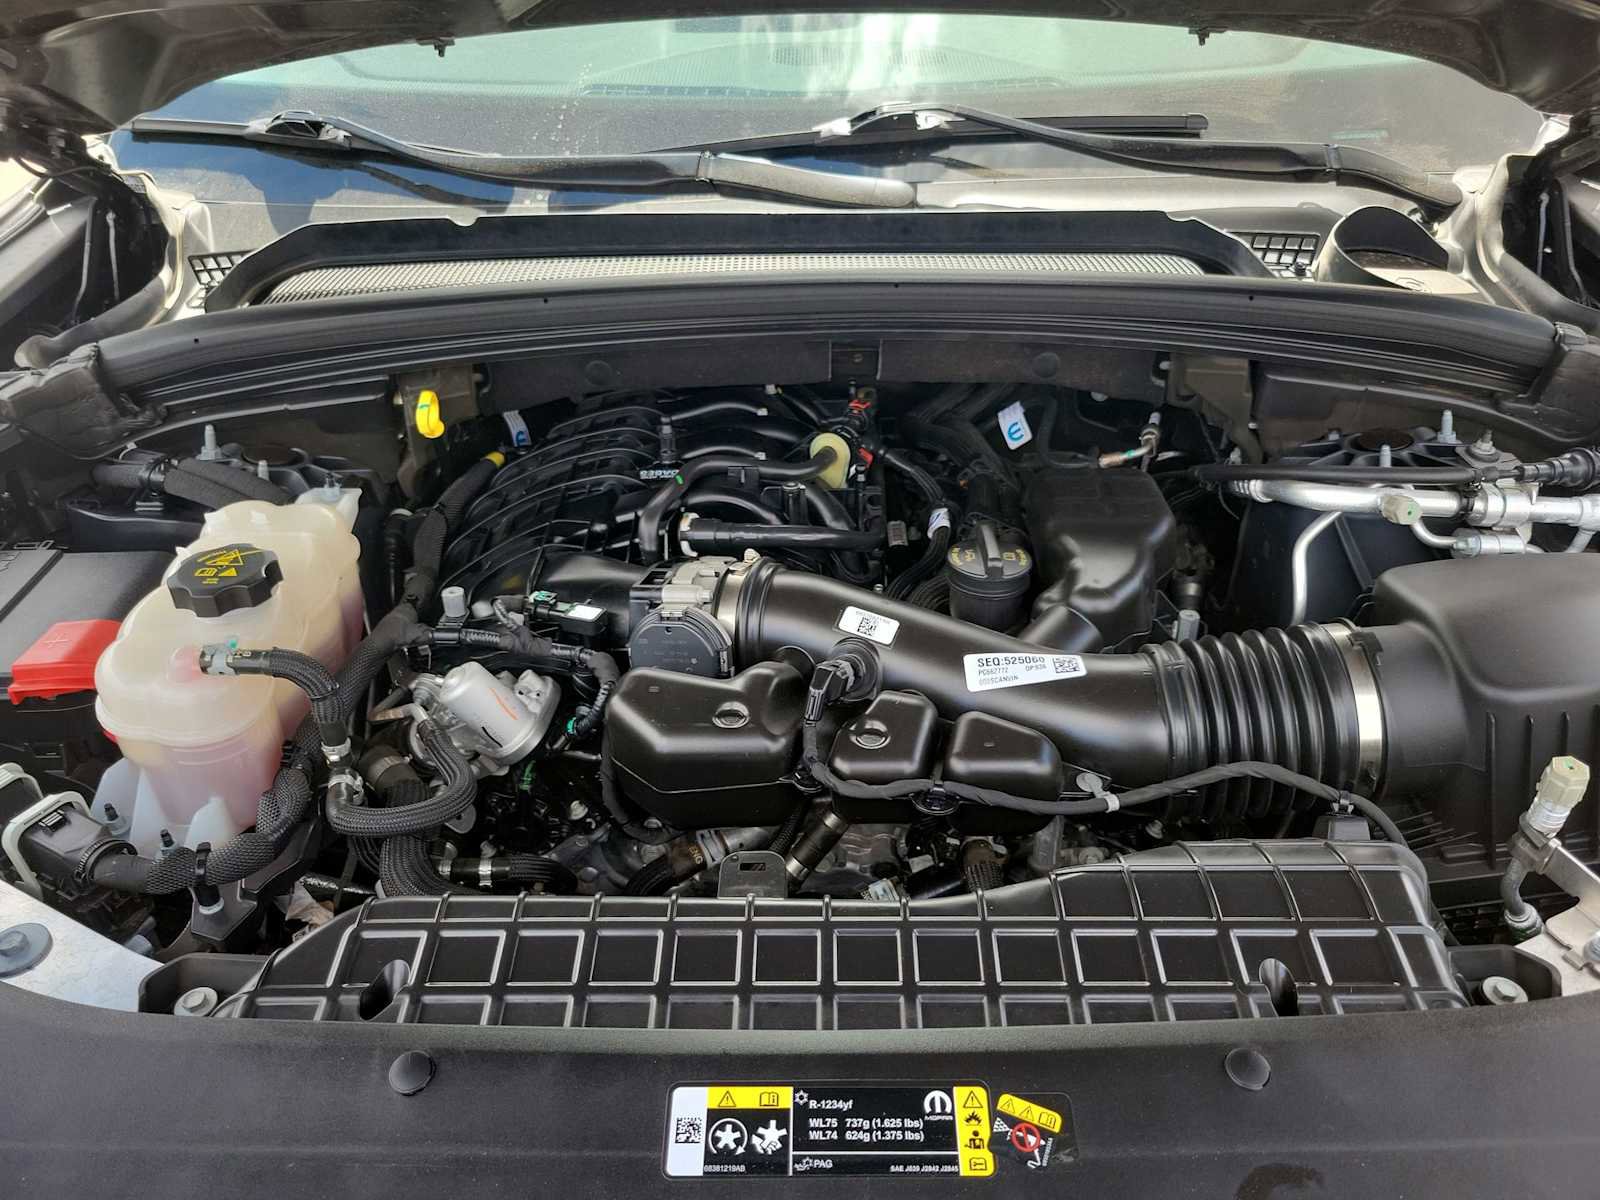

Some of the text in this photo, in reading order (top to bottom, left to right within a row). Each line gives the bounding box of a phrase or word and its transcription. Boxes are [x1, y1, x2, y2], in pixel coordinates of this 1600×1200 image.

[808, 1099, 854, 1111] R-1234yf
[808, 1118, 924, 1130] WL75 737g (1.625 lbs)
[808, 1130, 925, 1142] WL74 624g (1.375 lbs)
[813, 1159, 833, 1169] PAG
